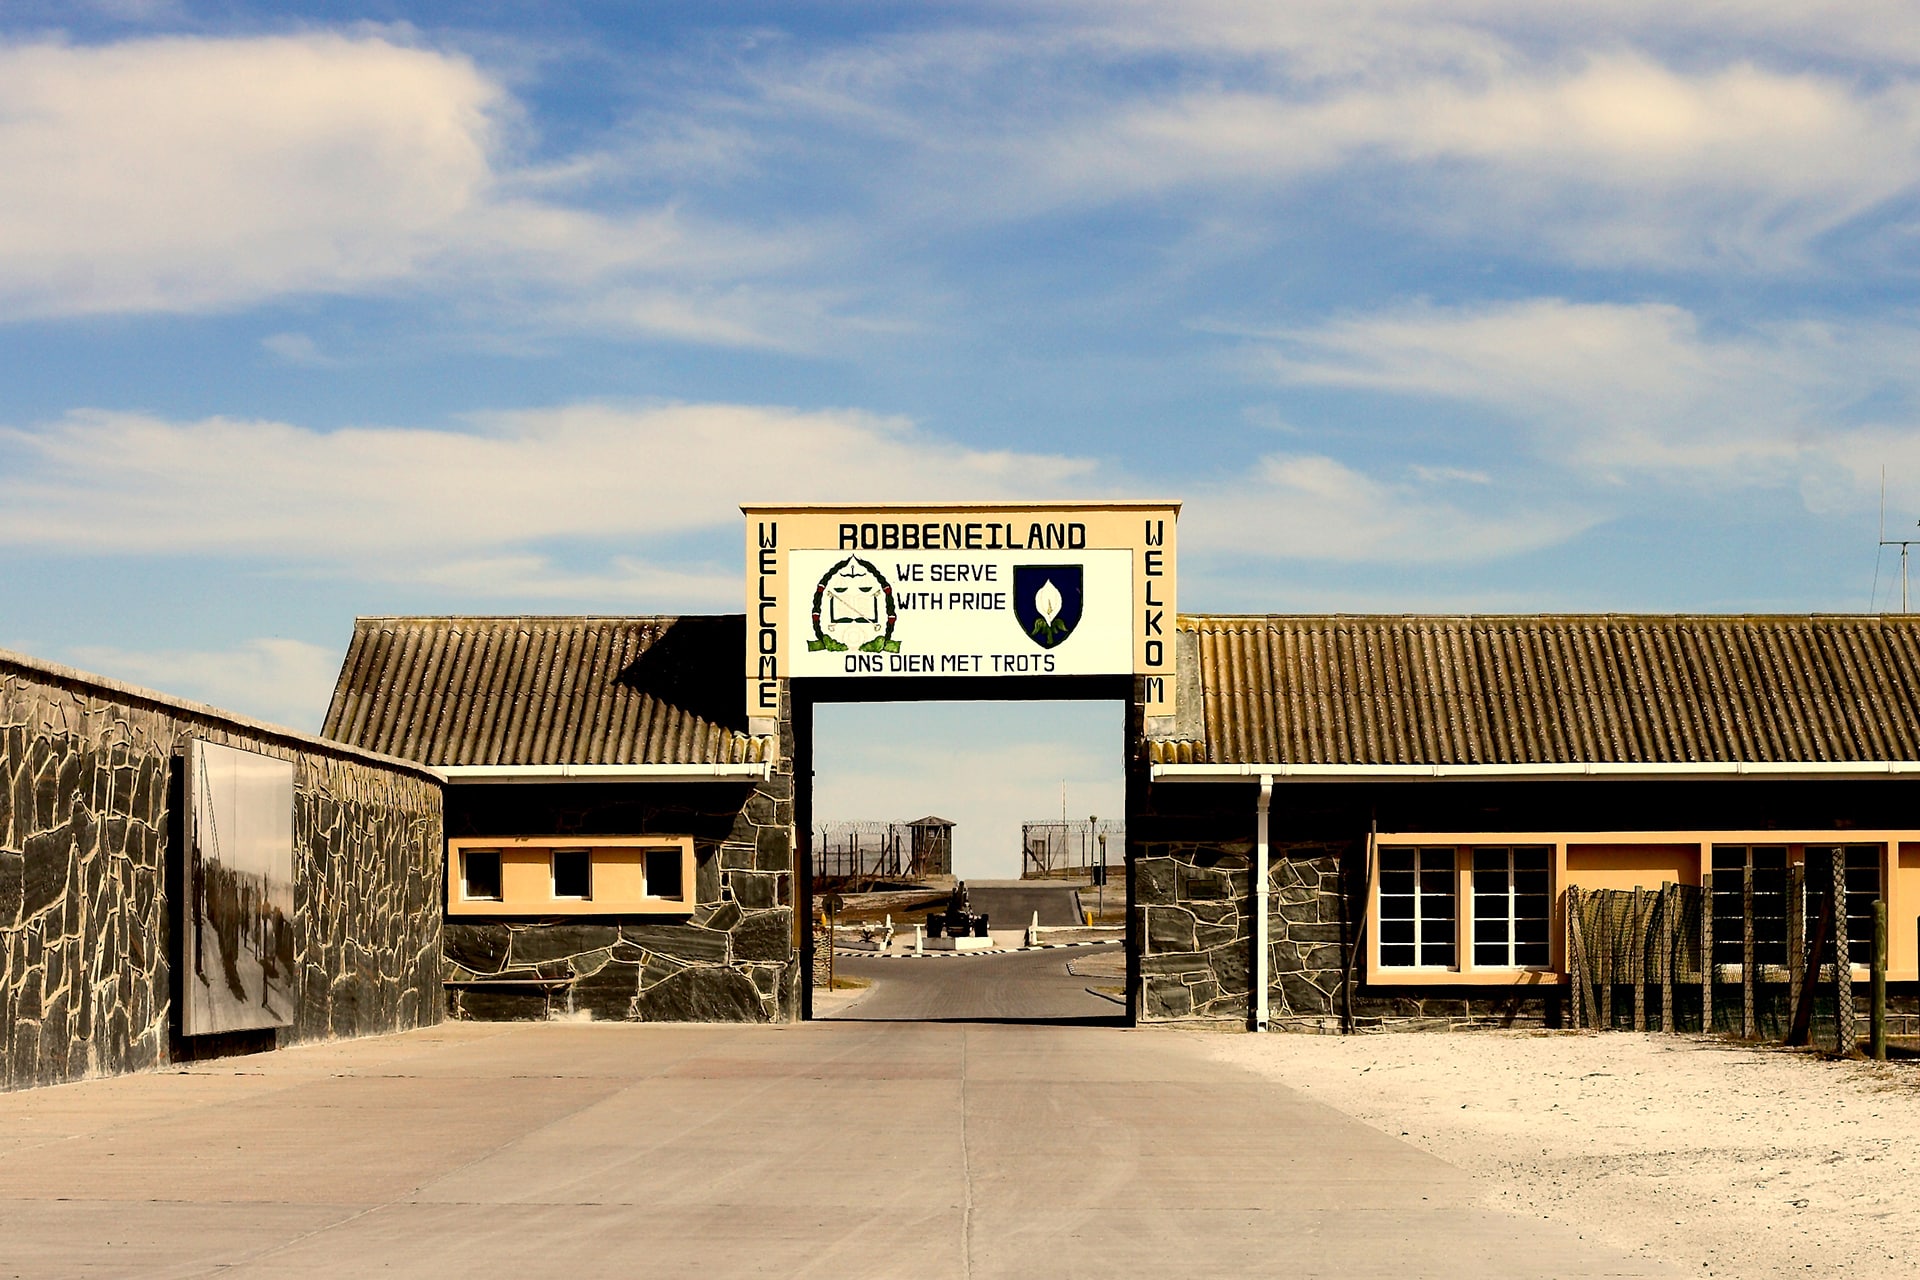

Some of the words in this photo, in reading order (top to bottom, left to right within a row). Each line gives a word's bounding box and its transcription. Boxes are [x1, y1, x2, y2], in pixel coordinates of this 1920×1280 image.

[839, 523, 1086, 550] ROBBENEILAND
[896, 564, 923, 581] WE
[930, 564, 997, 581] SERVE
[897, 592, 943, 610] WITH
[949, 592, 1006, 610] PRIDE
[1145, 520, 1163, 703] WELKOM
[758, 522, 777, 708] WELCOME
[845, 654, 883, 672] ONS
[890, 654, 934, 672] DIEN
[941, 654, 983, 672] MET
[991, 654, 1055, 672] TROTS
